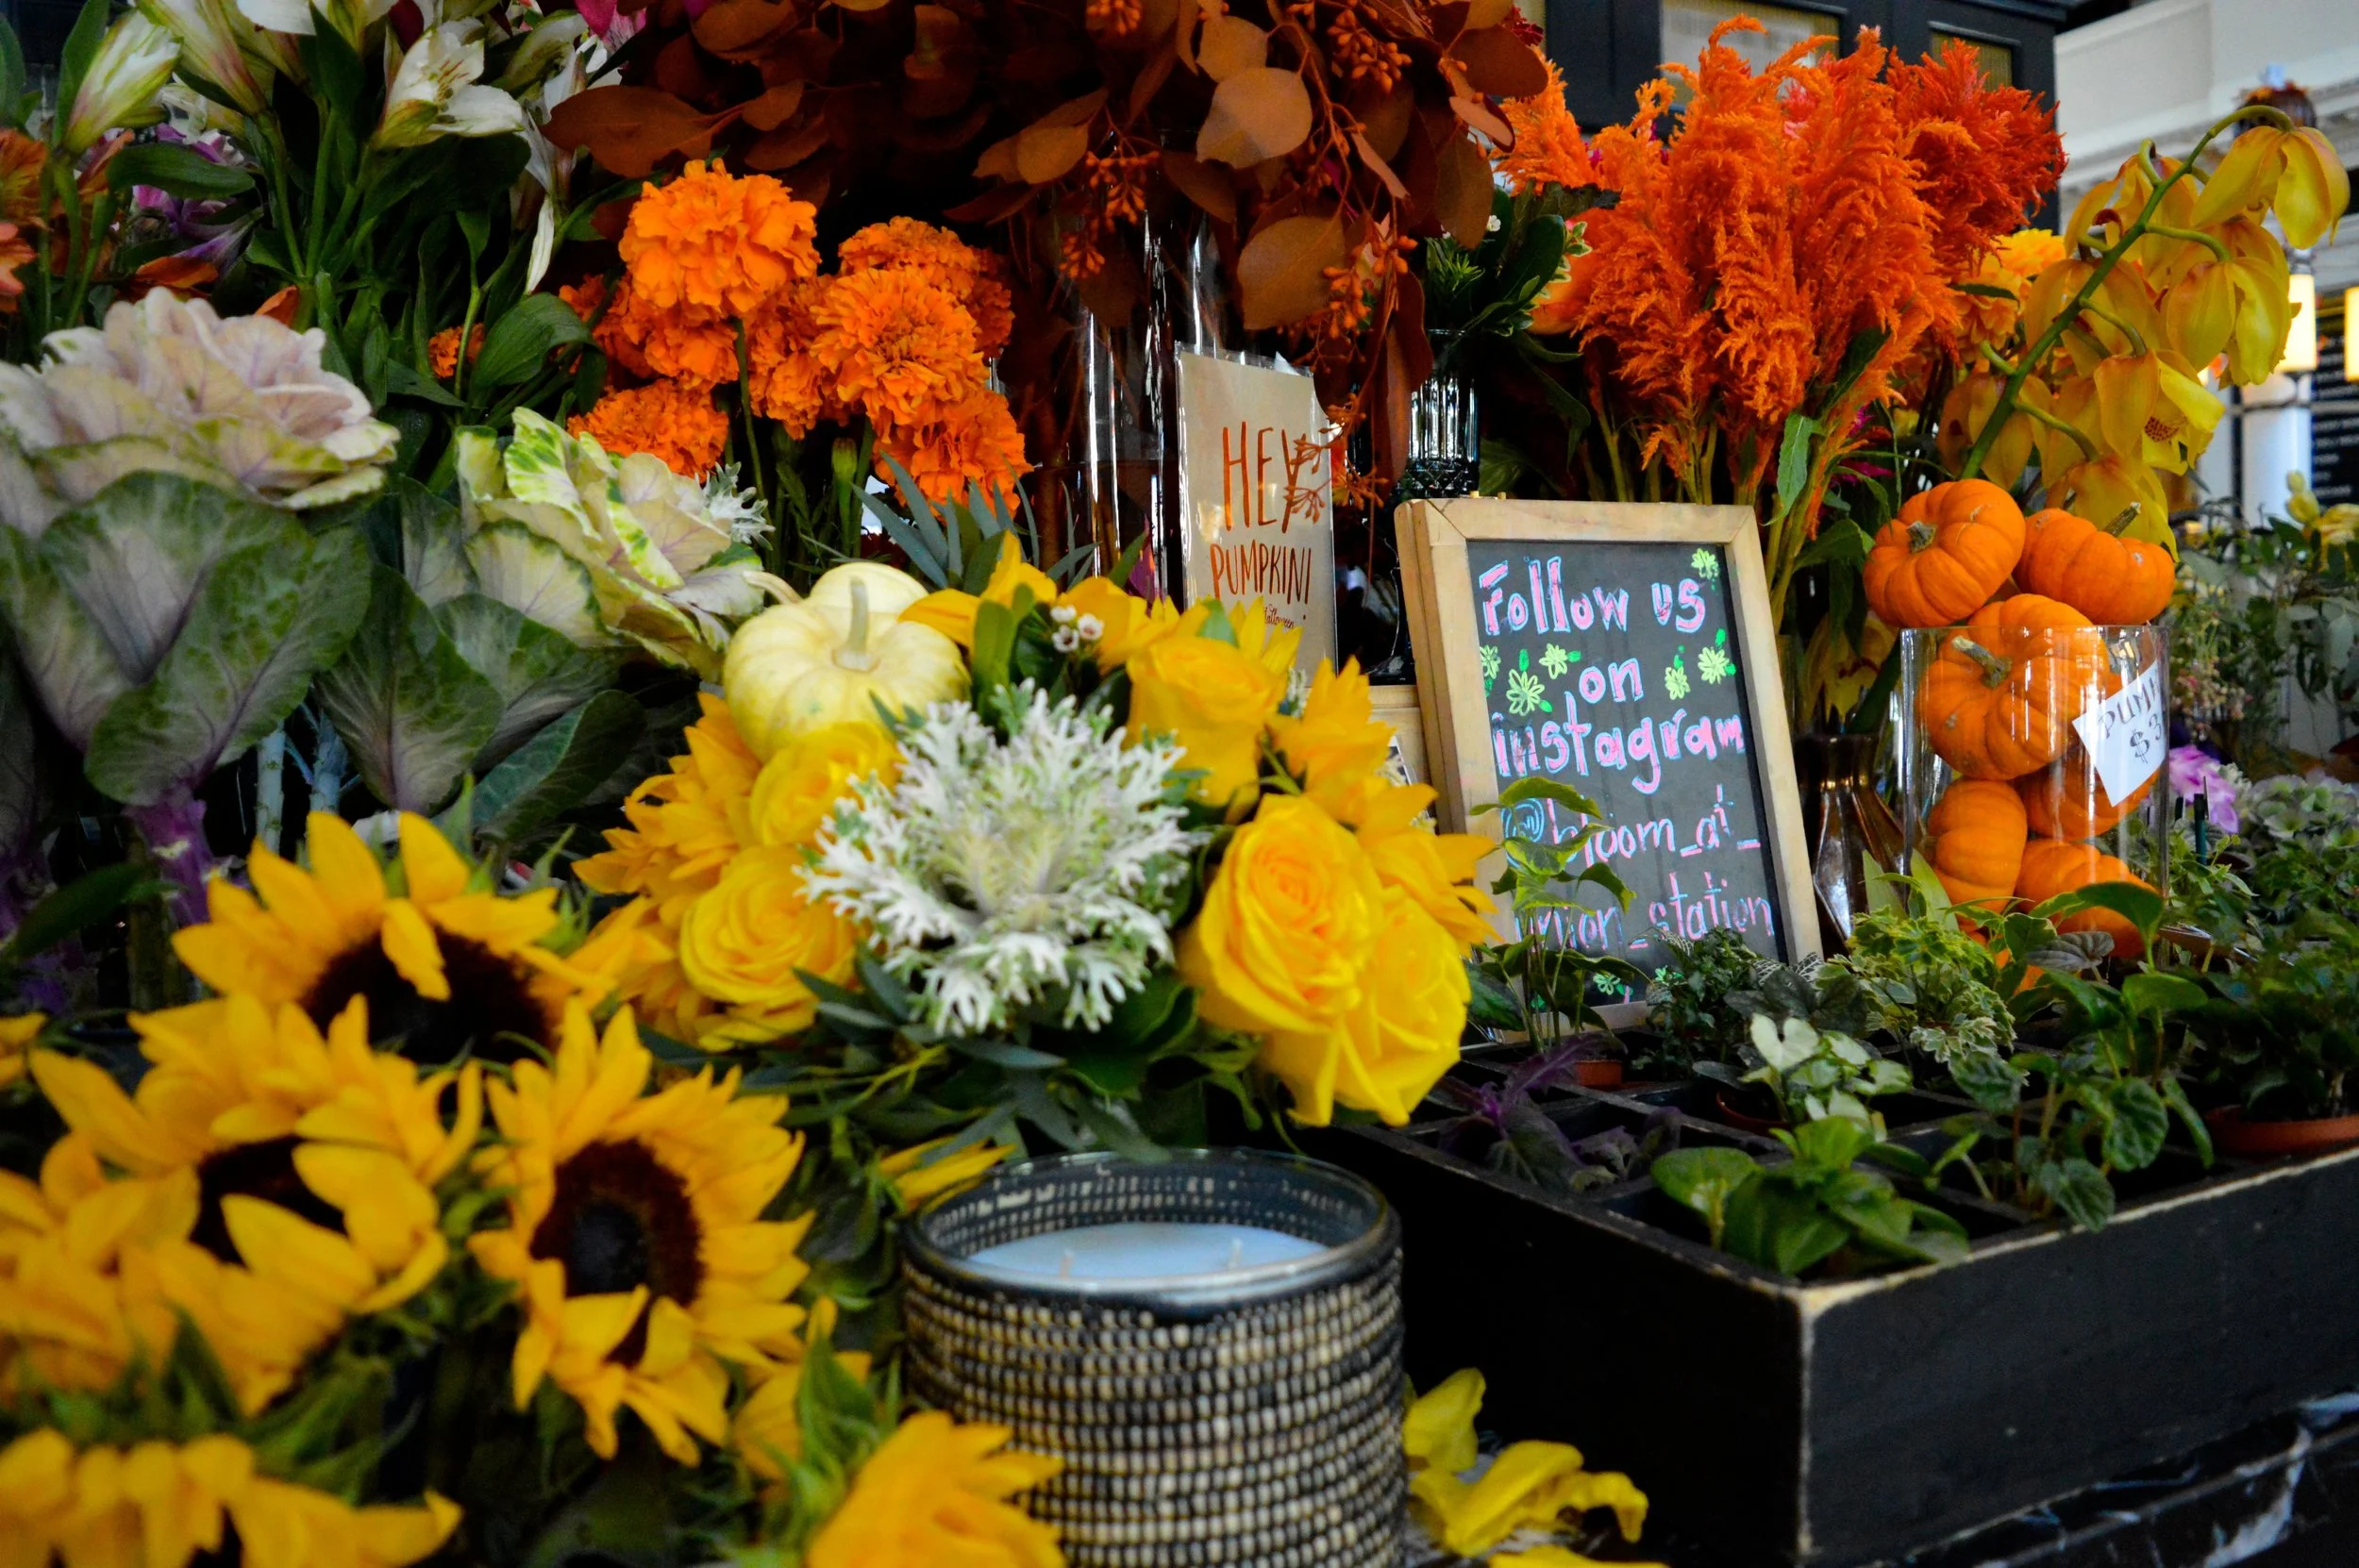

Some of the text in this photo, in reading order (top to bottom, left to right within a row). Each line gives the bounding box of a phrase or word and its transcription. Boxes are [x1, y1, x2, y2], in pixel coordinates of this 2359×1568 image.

[1222, 421, 1306, 533] HEY
[1210, 539, 1312, 620] PUMPKIN!
[1480, 556, 1706, 635] Follow us
[1579, 658, 1644, 704] on
[1491, 691, 1746, 794] instagram
